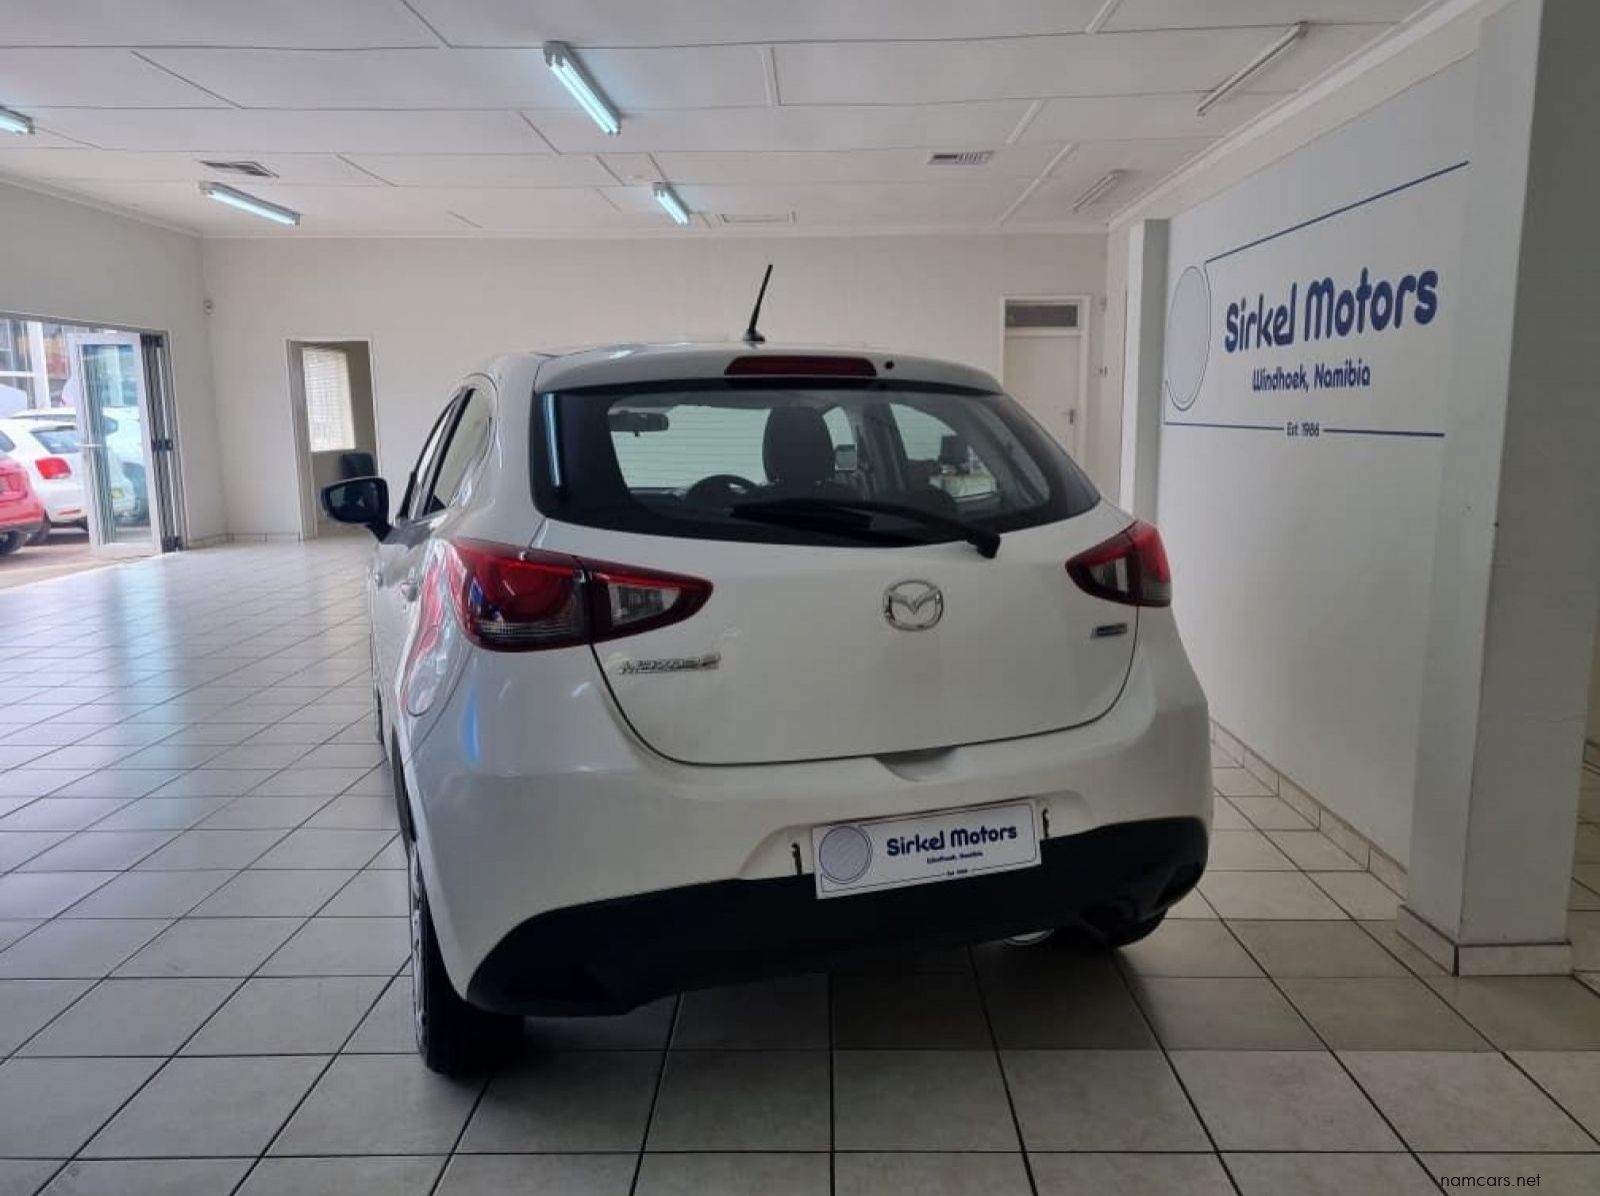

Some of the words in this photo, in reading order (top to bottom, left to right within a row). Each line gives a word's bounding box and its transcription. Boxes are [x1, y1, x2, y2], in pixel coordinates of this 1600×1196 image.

[1225, 282, 1297, 353] Sirkel
[1304, 266, 1439, 342] Motors
[1313, 358, 1371, 389] Namibia
[886, 830, 944, 856] Sirkel
[950, 825, 1017, 848] Motors
